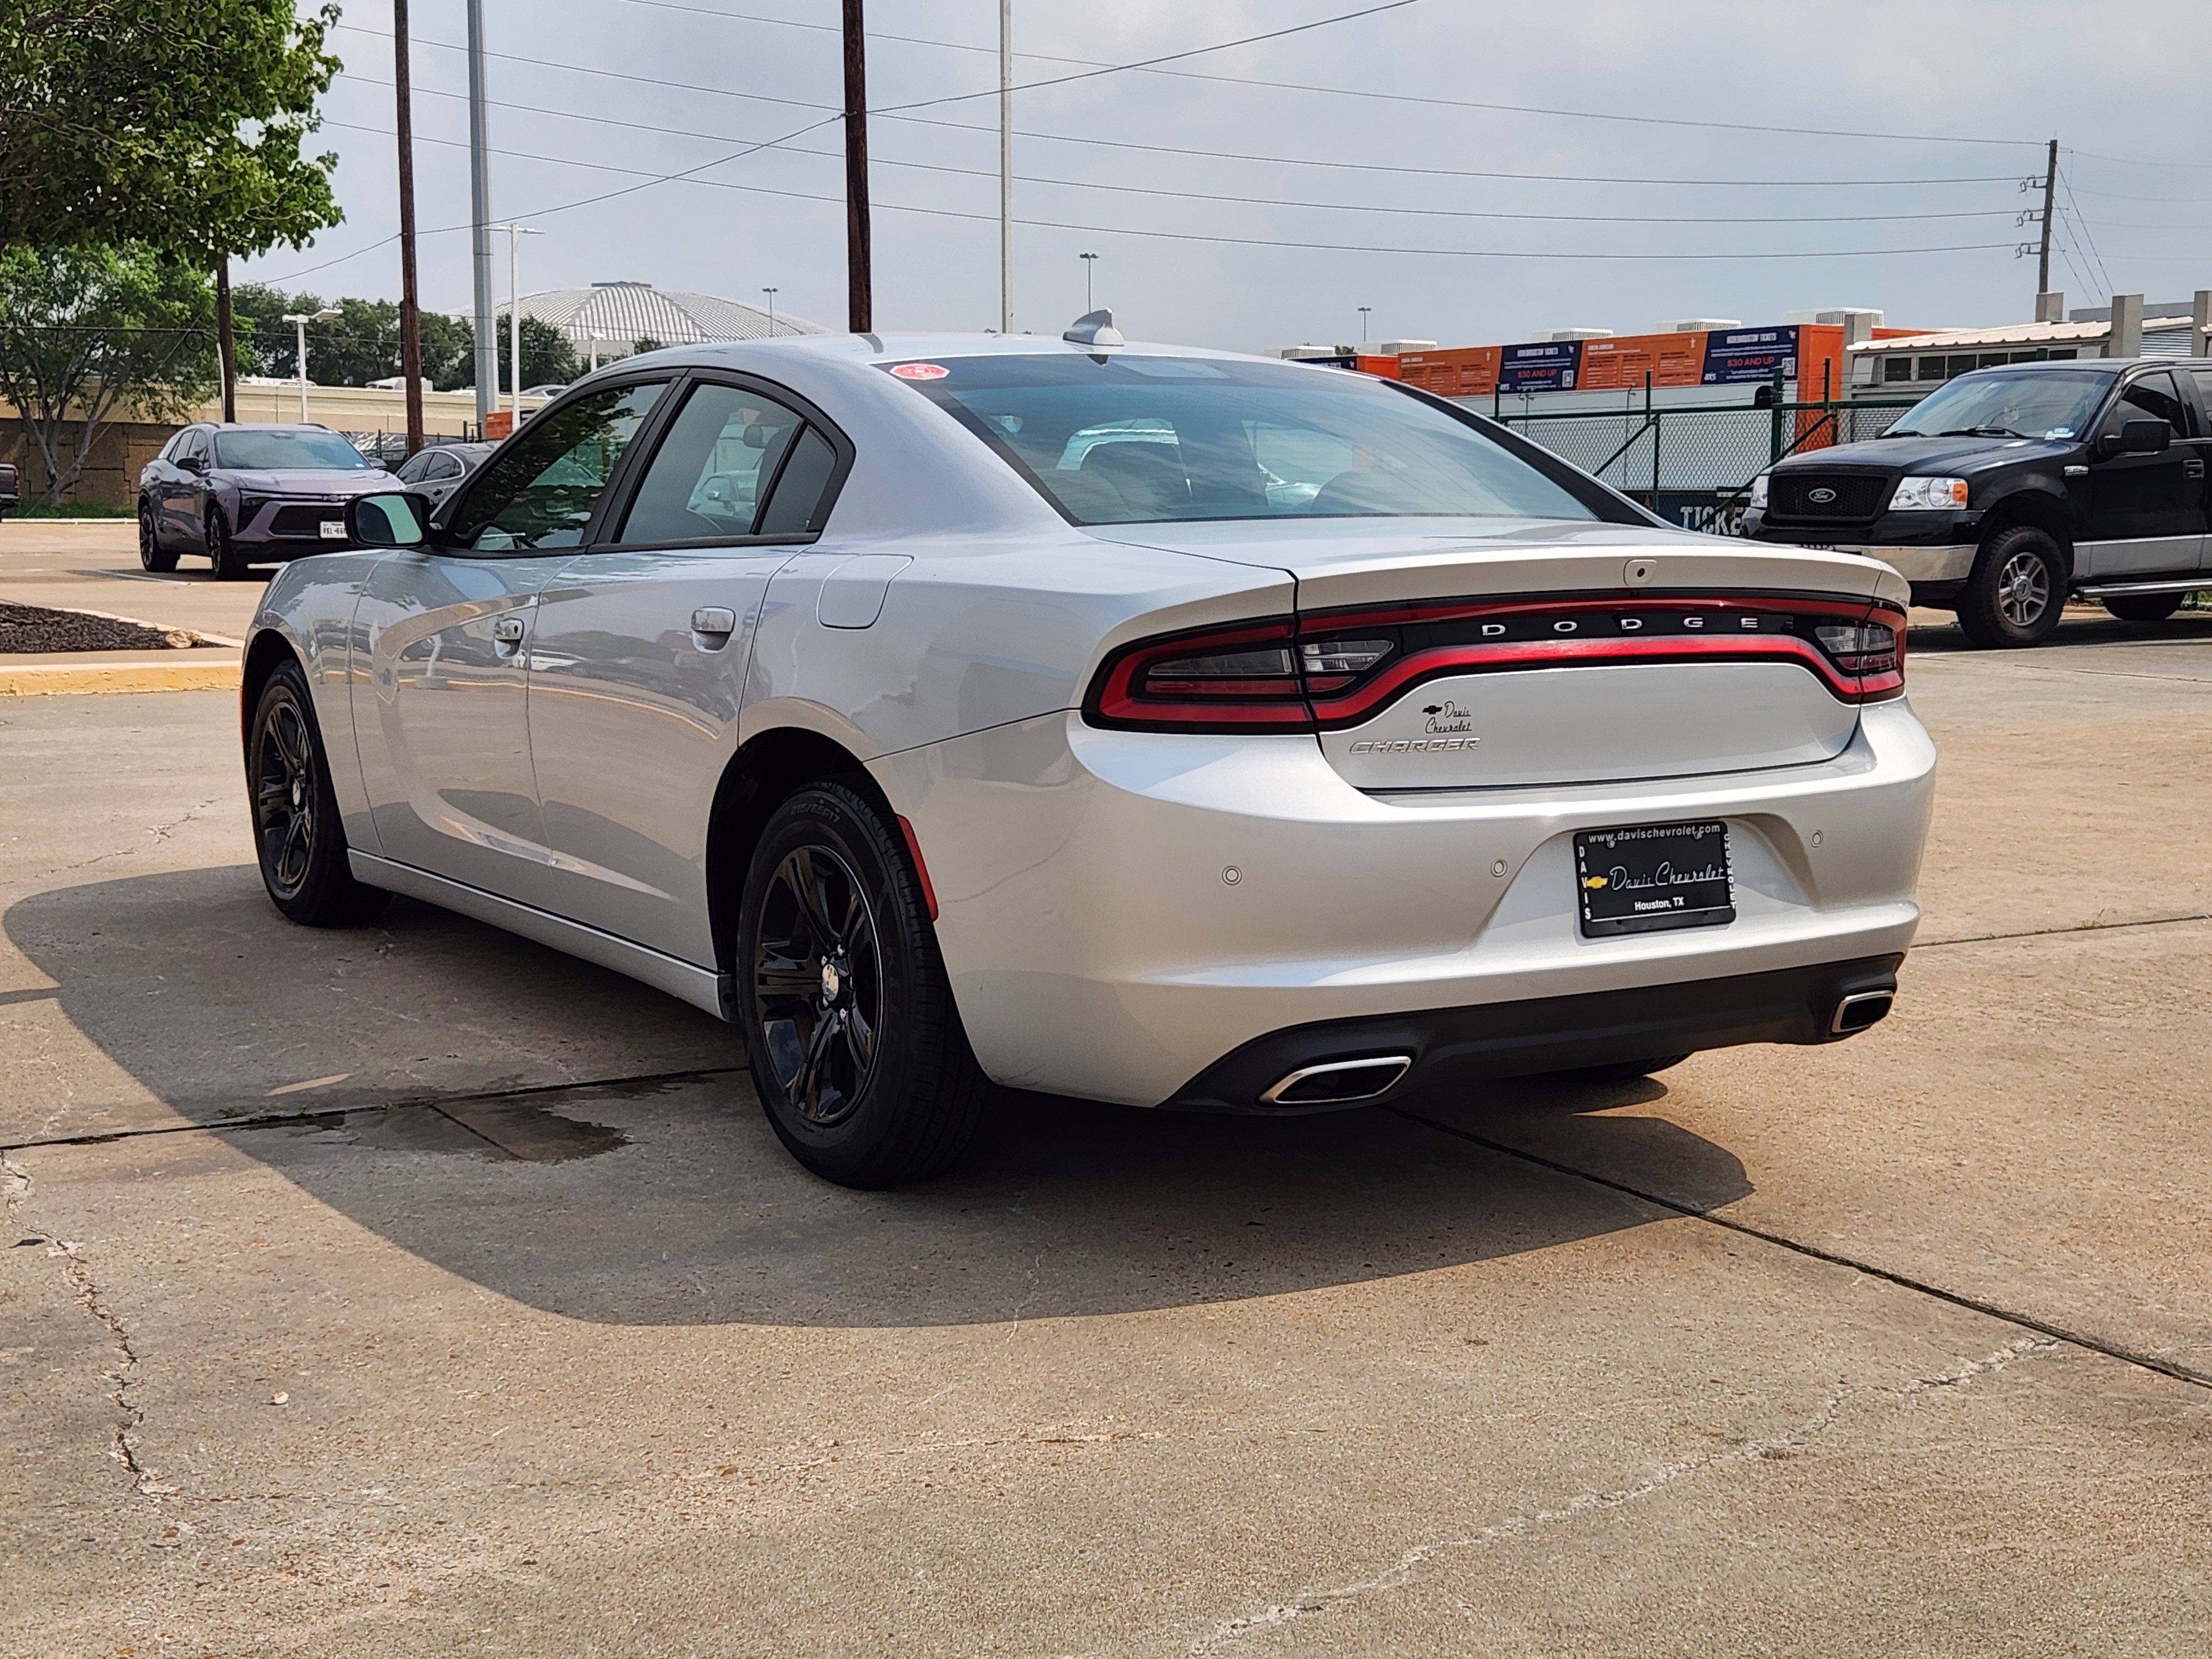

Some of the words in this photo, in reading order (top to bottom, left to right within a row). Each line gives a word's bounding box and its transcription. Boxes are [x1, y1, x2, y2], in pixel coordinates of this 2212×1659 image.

[1727, 359, 1743, 367] $30
[1744, 358, 1762, 367] AND
[1763, 356, 1775, 364] UP
[1531, 369, 1547, 378] AND
[1679, 506, 1747, 536] TICKE
[1481, 617, 1759, 636] DODGE
[1444, 701, 1472, 718] Davis
[1425, 717, 1473, 734] Chevrolet
[1349, 737, 1481, 754] CHARGER
[1588, 824, 1720, 843] www.davischevrolet.com
[1609, 866, 1655, 890] Davis
[1655, 862, 1726, 885] Chevrolet
[1723, 833, 1737, 910] CHEVROLET
[1578, 846, 1591, 920] DAVIS
[1634, 899, 1672, 911] Houston,
[1672, 896, 1684, 907] TX
